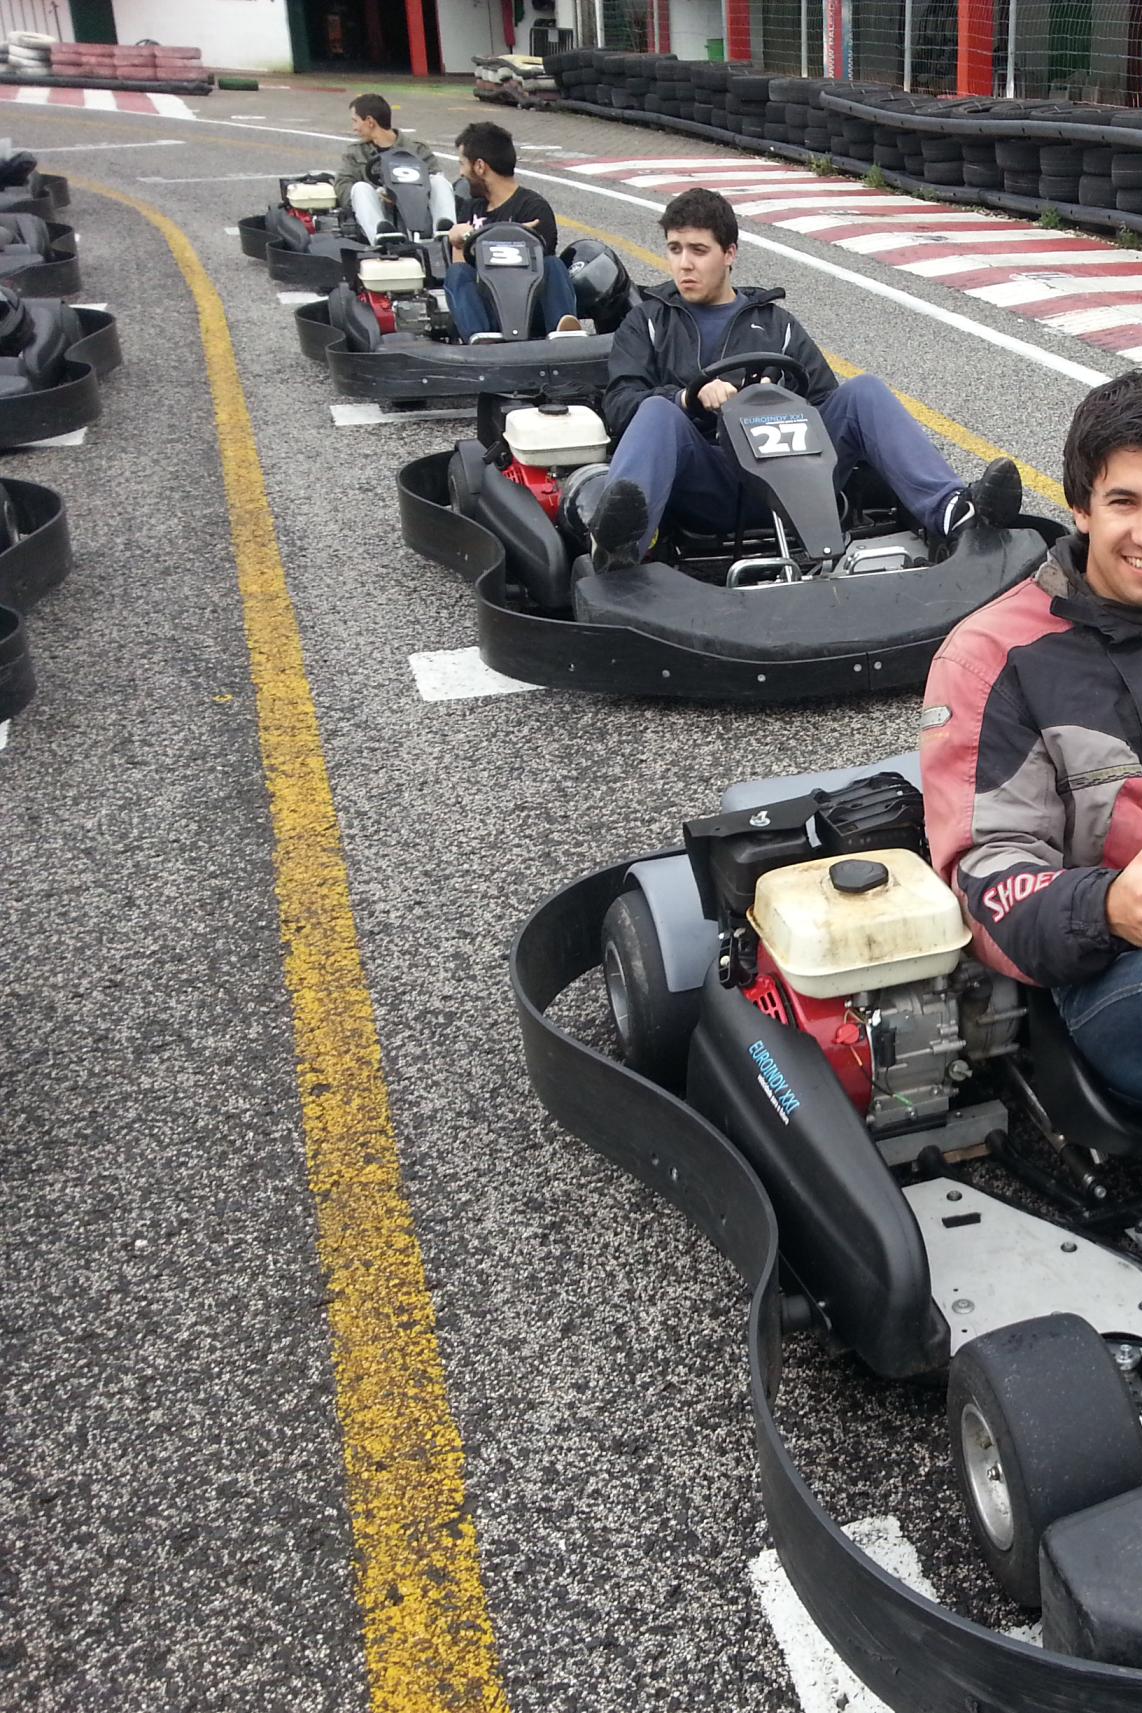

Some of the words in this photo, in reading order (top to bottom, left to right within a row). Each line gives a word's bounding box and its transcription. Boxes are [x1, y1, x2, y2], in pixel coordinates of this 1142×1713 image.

[392, 167, 420, 182] 9
[489, 246, 523, 265] 3
[750, 423, 808, 454] 27
[748, 1040, 789, 1093] EUROINDY
[779, 1088, 800, 1114] XXI
